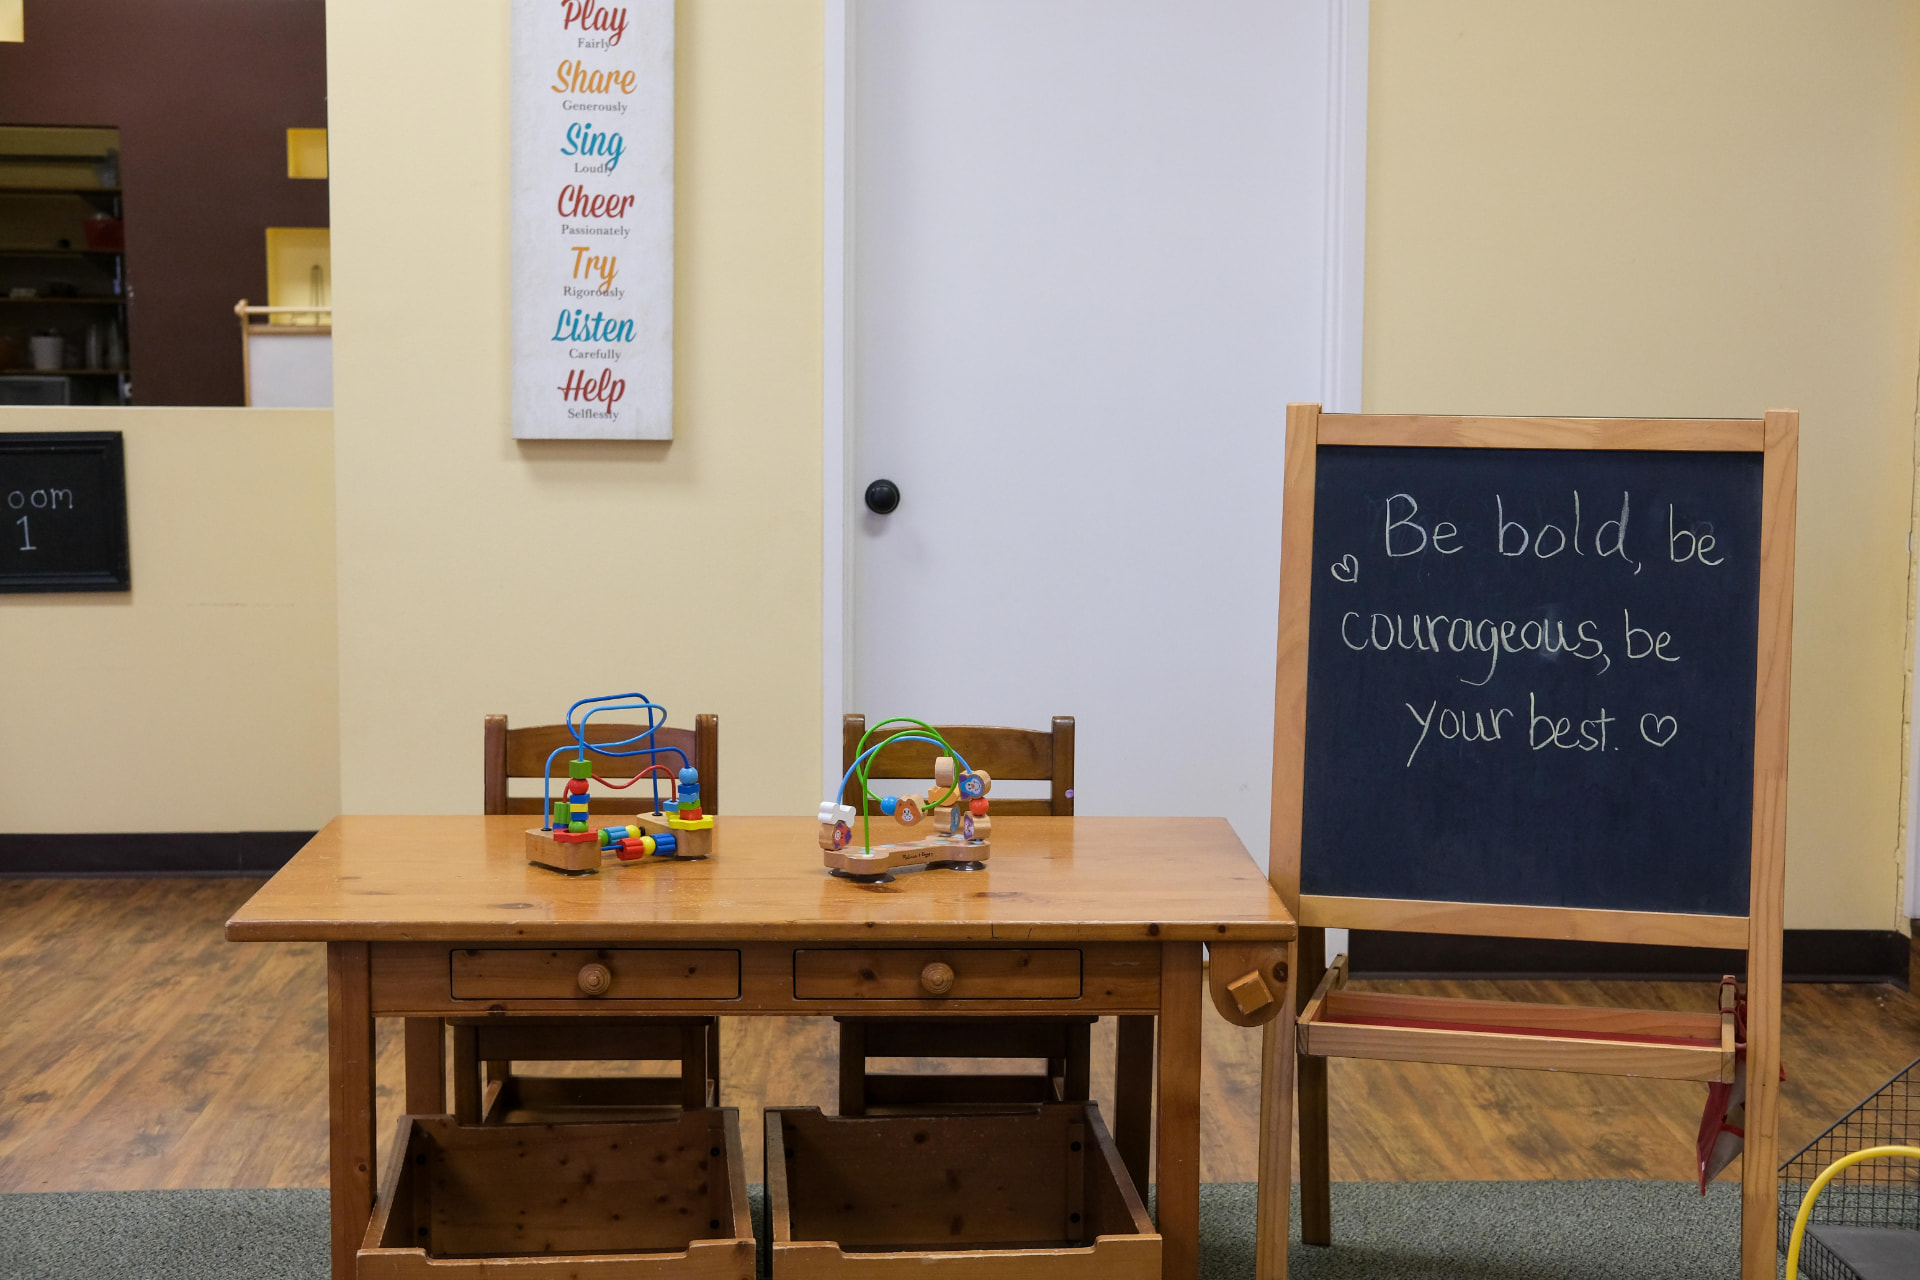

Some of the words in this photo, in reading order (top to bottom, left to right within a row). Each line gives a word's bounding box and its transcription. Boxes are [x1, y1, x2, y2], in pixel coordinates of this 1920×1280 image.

[561, 0, 629, 46] Play
[577, 38, 610, 52] Fairly
[551, 59, 637, 94] Share
[562, 100, 628, 114] Generously
[560, 122, 626, 171] Sing
[574, 163, 613, 176] Loudly
[557, 184, 635, 218] Cheer
[561, 225, 630, 239] Passionately
[571, 246, 619, 293] Try
[563, 286, 625, 300] Rigorously
[551, 309, 637, 343] Listen
[569, 348, 621, 362] Carefully
[557, 368, 626, 414] Help
[567, 408, 619, 422] Selflessly
[16, 515, 37, 551] 1
[1385, 493, 1463, 557] Be
[1496, 490, 1642, 575] bold,
[1669, 503, 1725, 566] be
[1341, 611, 1611, 686] courageous,
[1624, 608, 1681, 661] be
[1405, 700, 1514, 768] your
[1530, 692, 1619, 752] best.
